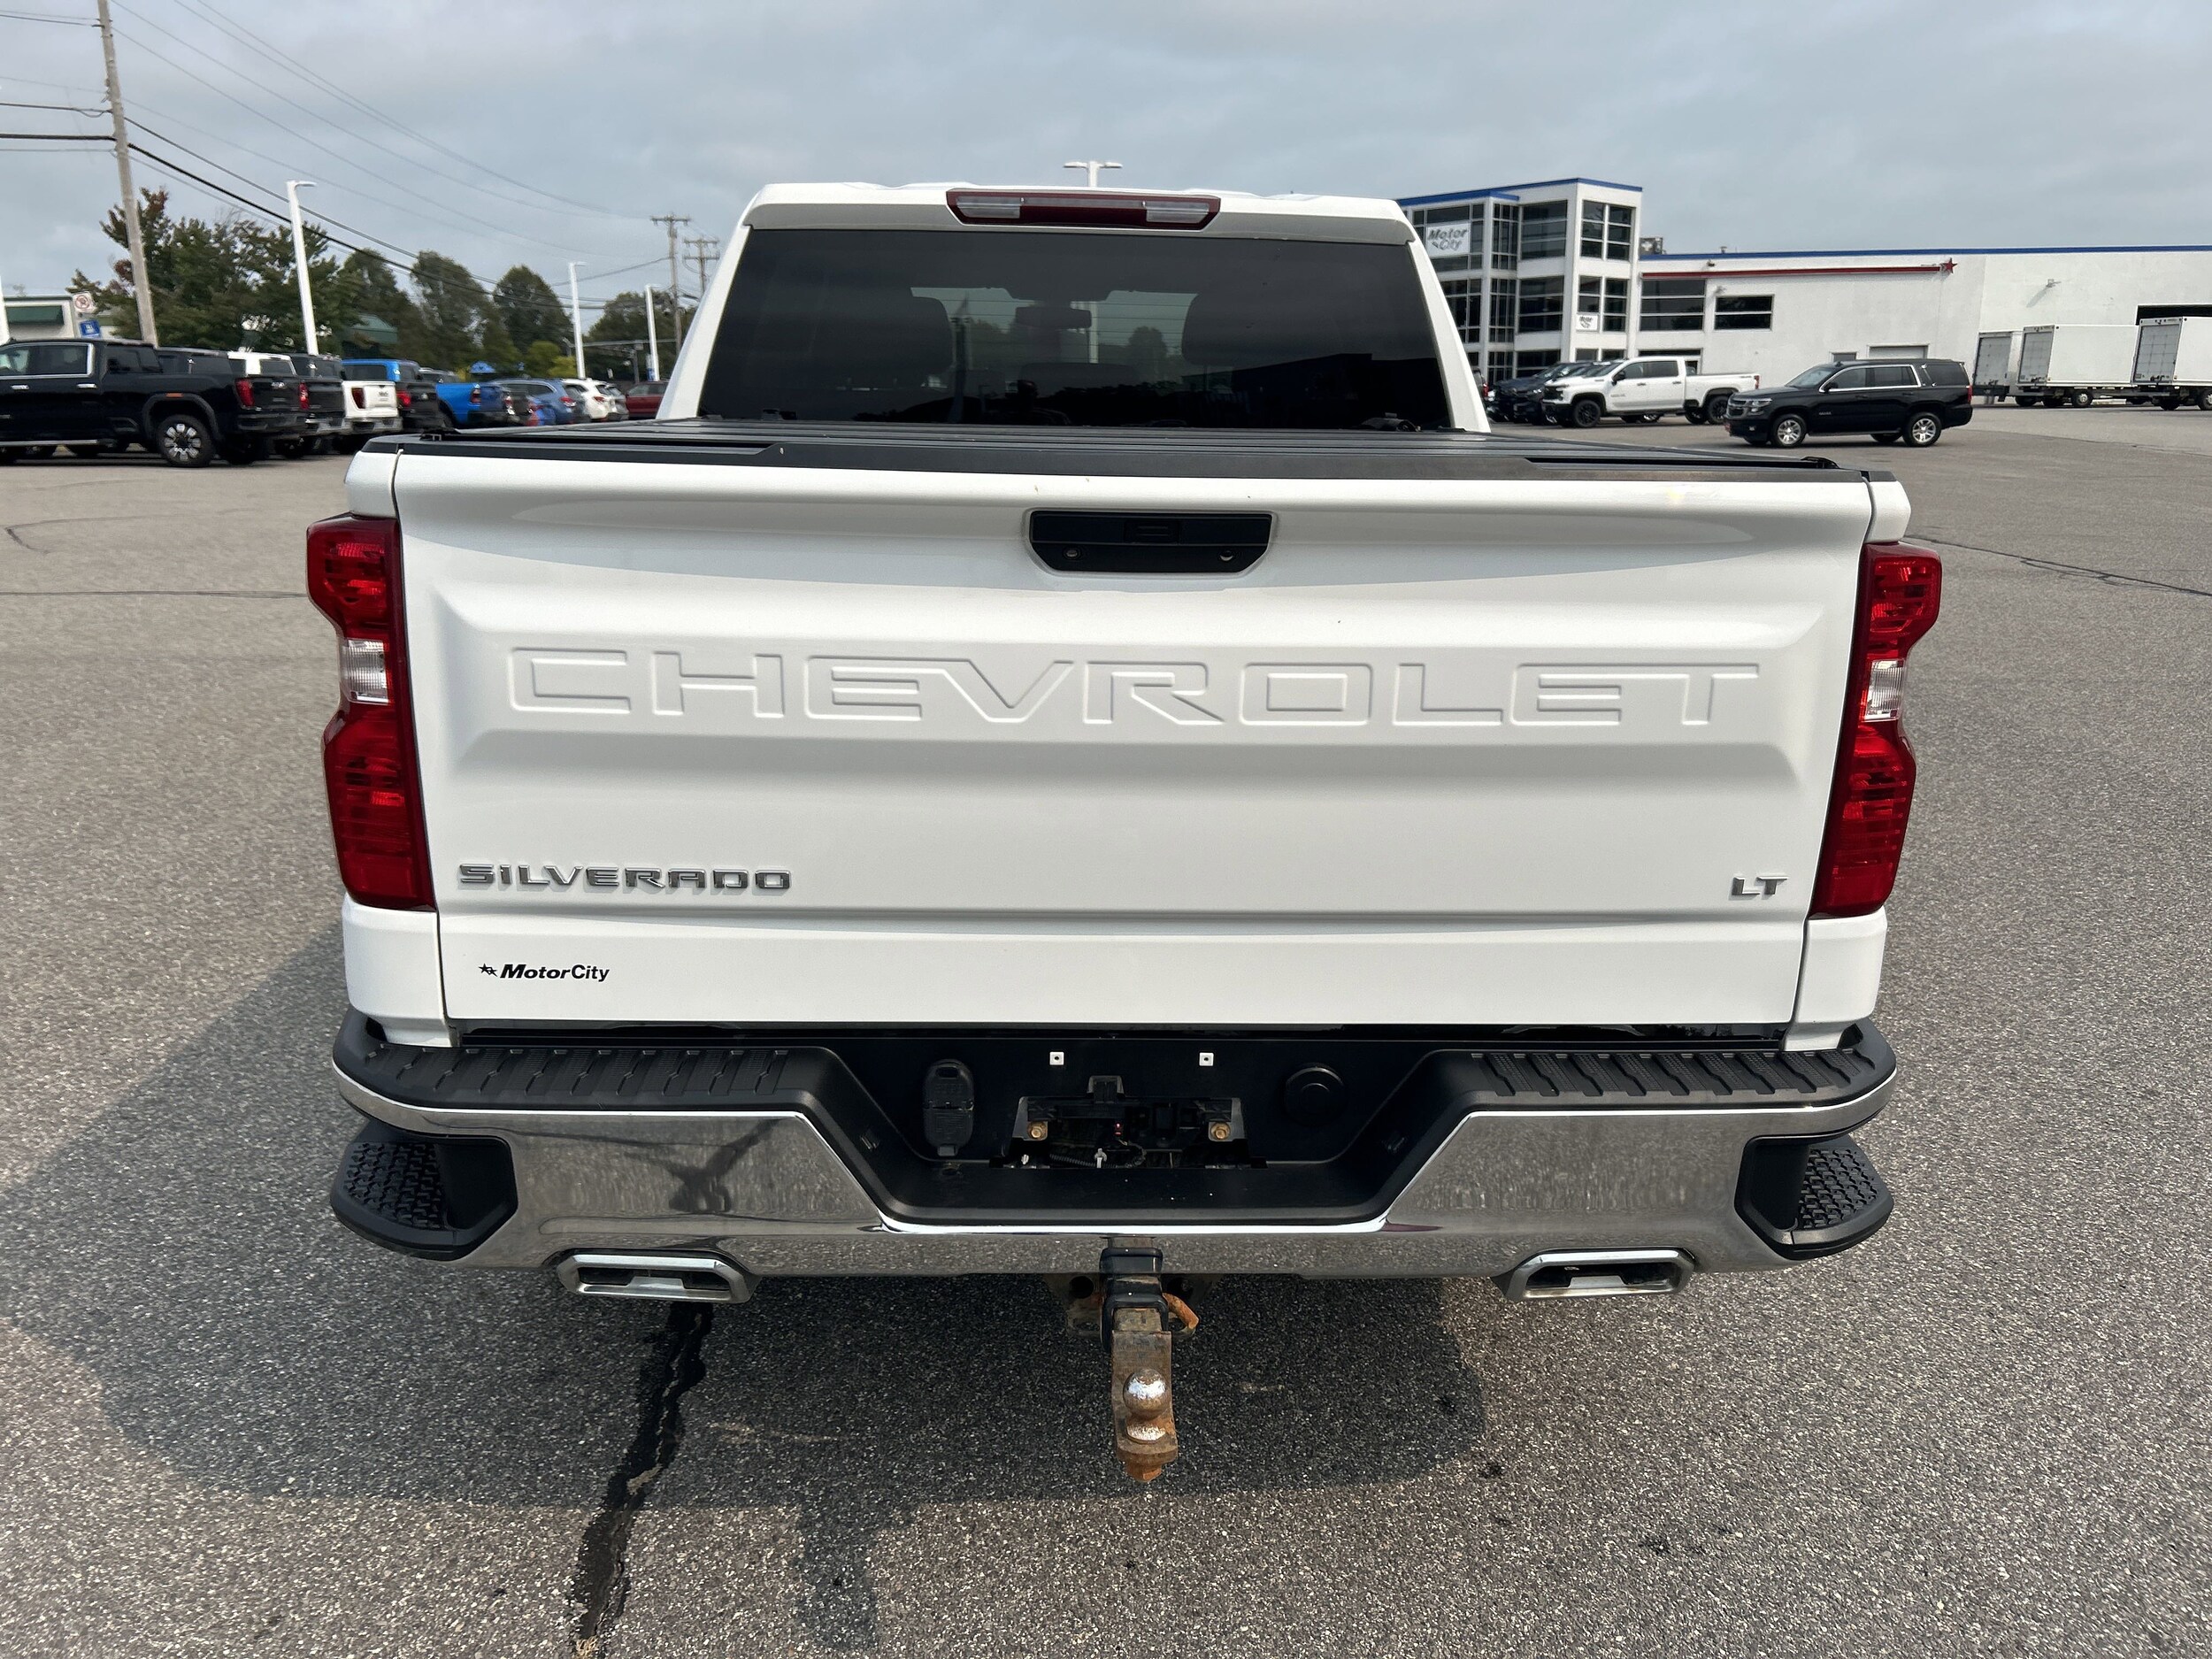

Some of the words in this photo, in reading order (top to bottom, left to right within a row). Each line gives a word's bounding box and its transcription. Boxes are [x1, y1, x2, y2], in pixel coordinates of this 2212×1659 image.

[1427, 228, 1468, 240] Motor
[508, 647, 1760, 726] CHEVROLET
[459, 863, 792, 890] SILVERADO
[1731, 875, 1789, 895] LT
[499, 964, 611, 982] MotorCity
